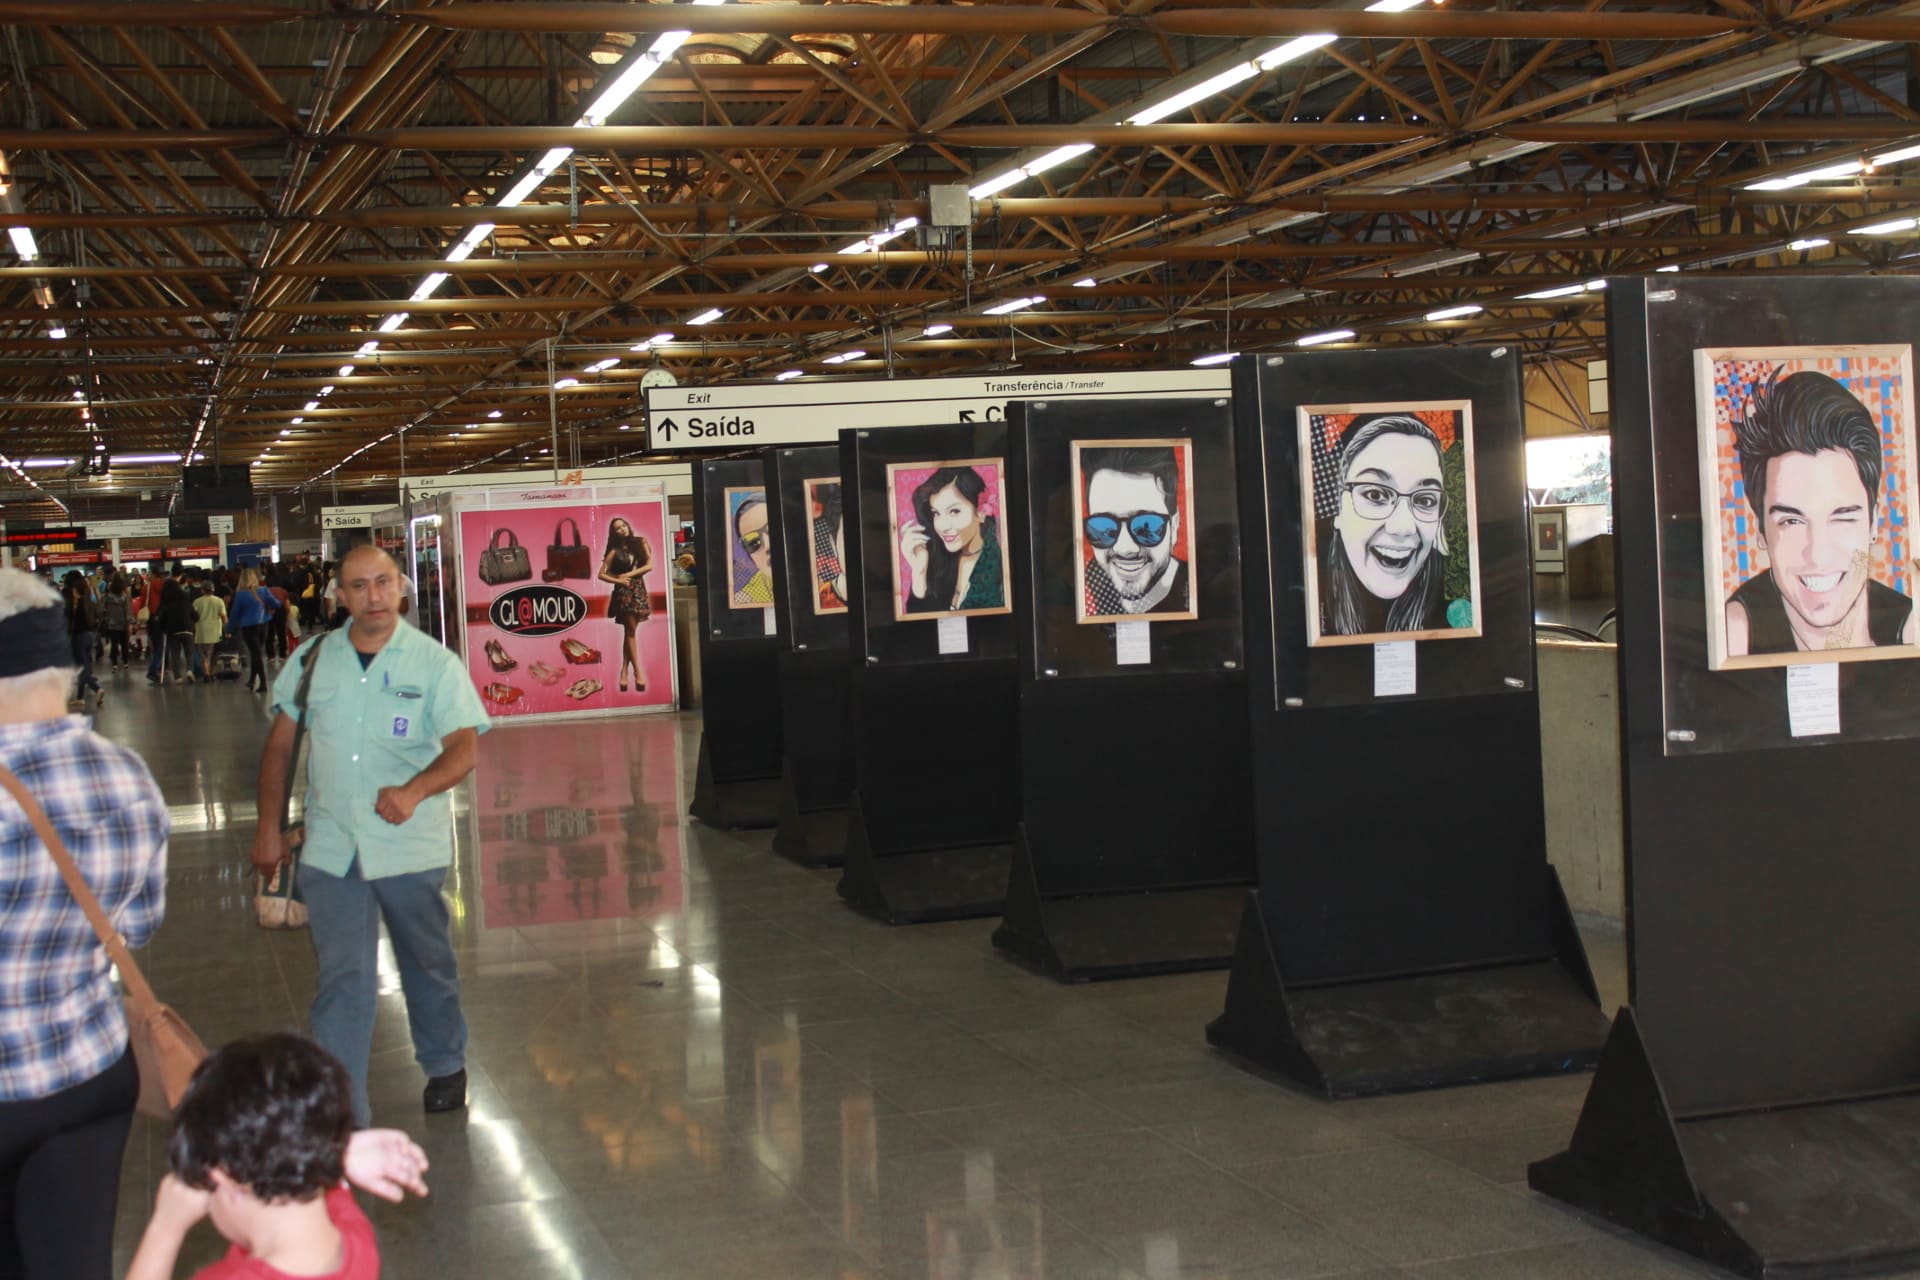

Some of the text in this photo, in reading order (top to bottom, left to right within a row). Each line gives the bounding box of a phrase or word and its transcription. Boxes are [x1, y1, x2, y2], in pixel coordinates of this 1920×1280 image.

[984, 380, 1063, 393] Transferência
[687, 393, 711, 404] Exit
[688, 416, 755, 438] Saída
[335, 517, 362, 526] Saída
[500, 596, 576, 626] GL@MOUR
